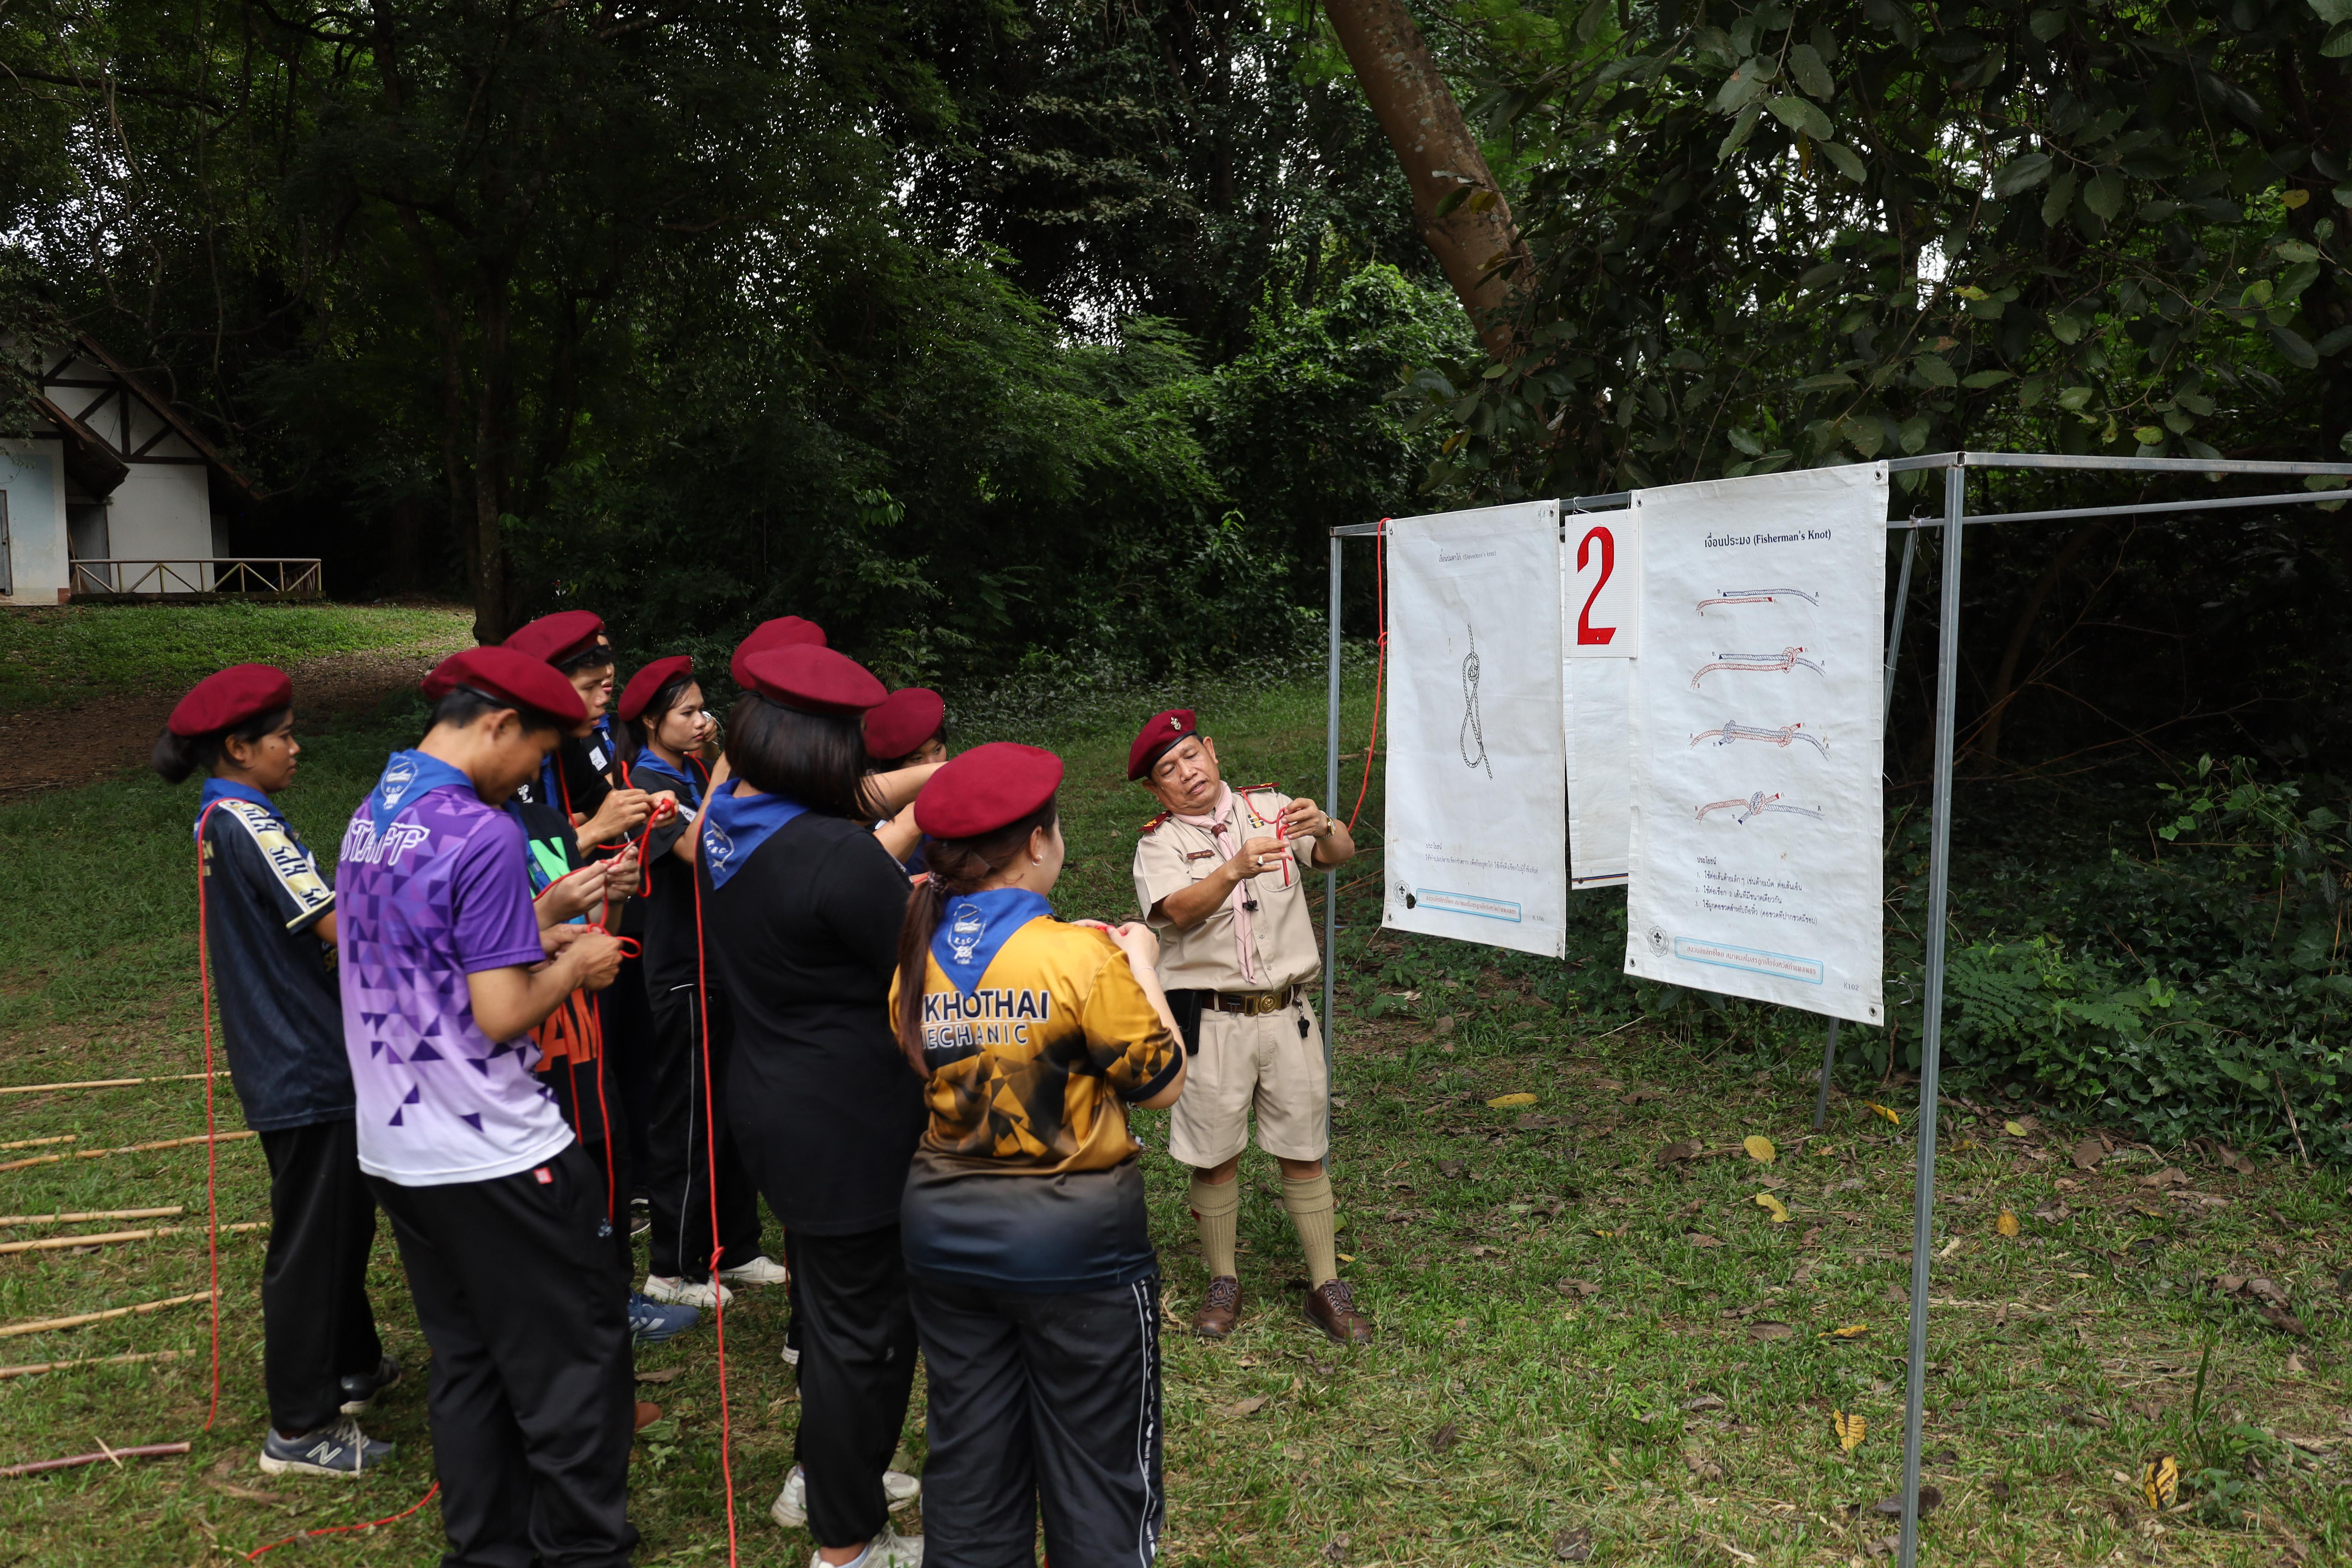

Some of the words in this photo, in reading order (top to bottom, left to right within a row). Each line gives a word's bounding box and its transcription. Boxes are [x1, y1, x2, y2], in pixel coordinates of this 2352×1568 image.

[1705, 533, 1750, 547] เงื่อนประมง
[1753, 531, 1805, 546] (Fisherman's
[1808, 528, 1831, 541] Knot)
[1577, 527, 1616, 645] 2
[1697, 856, 1717, 865] ประโยชน์
[1844, 982, 1859, 991] K102
[923, 988, 1050, 1022] KHOTHAI
[921, 1023, 1028, 1049] ECHANIC
[306, 1441, 343, 1465] N
